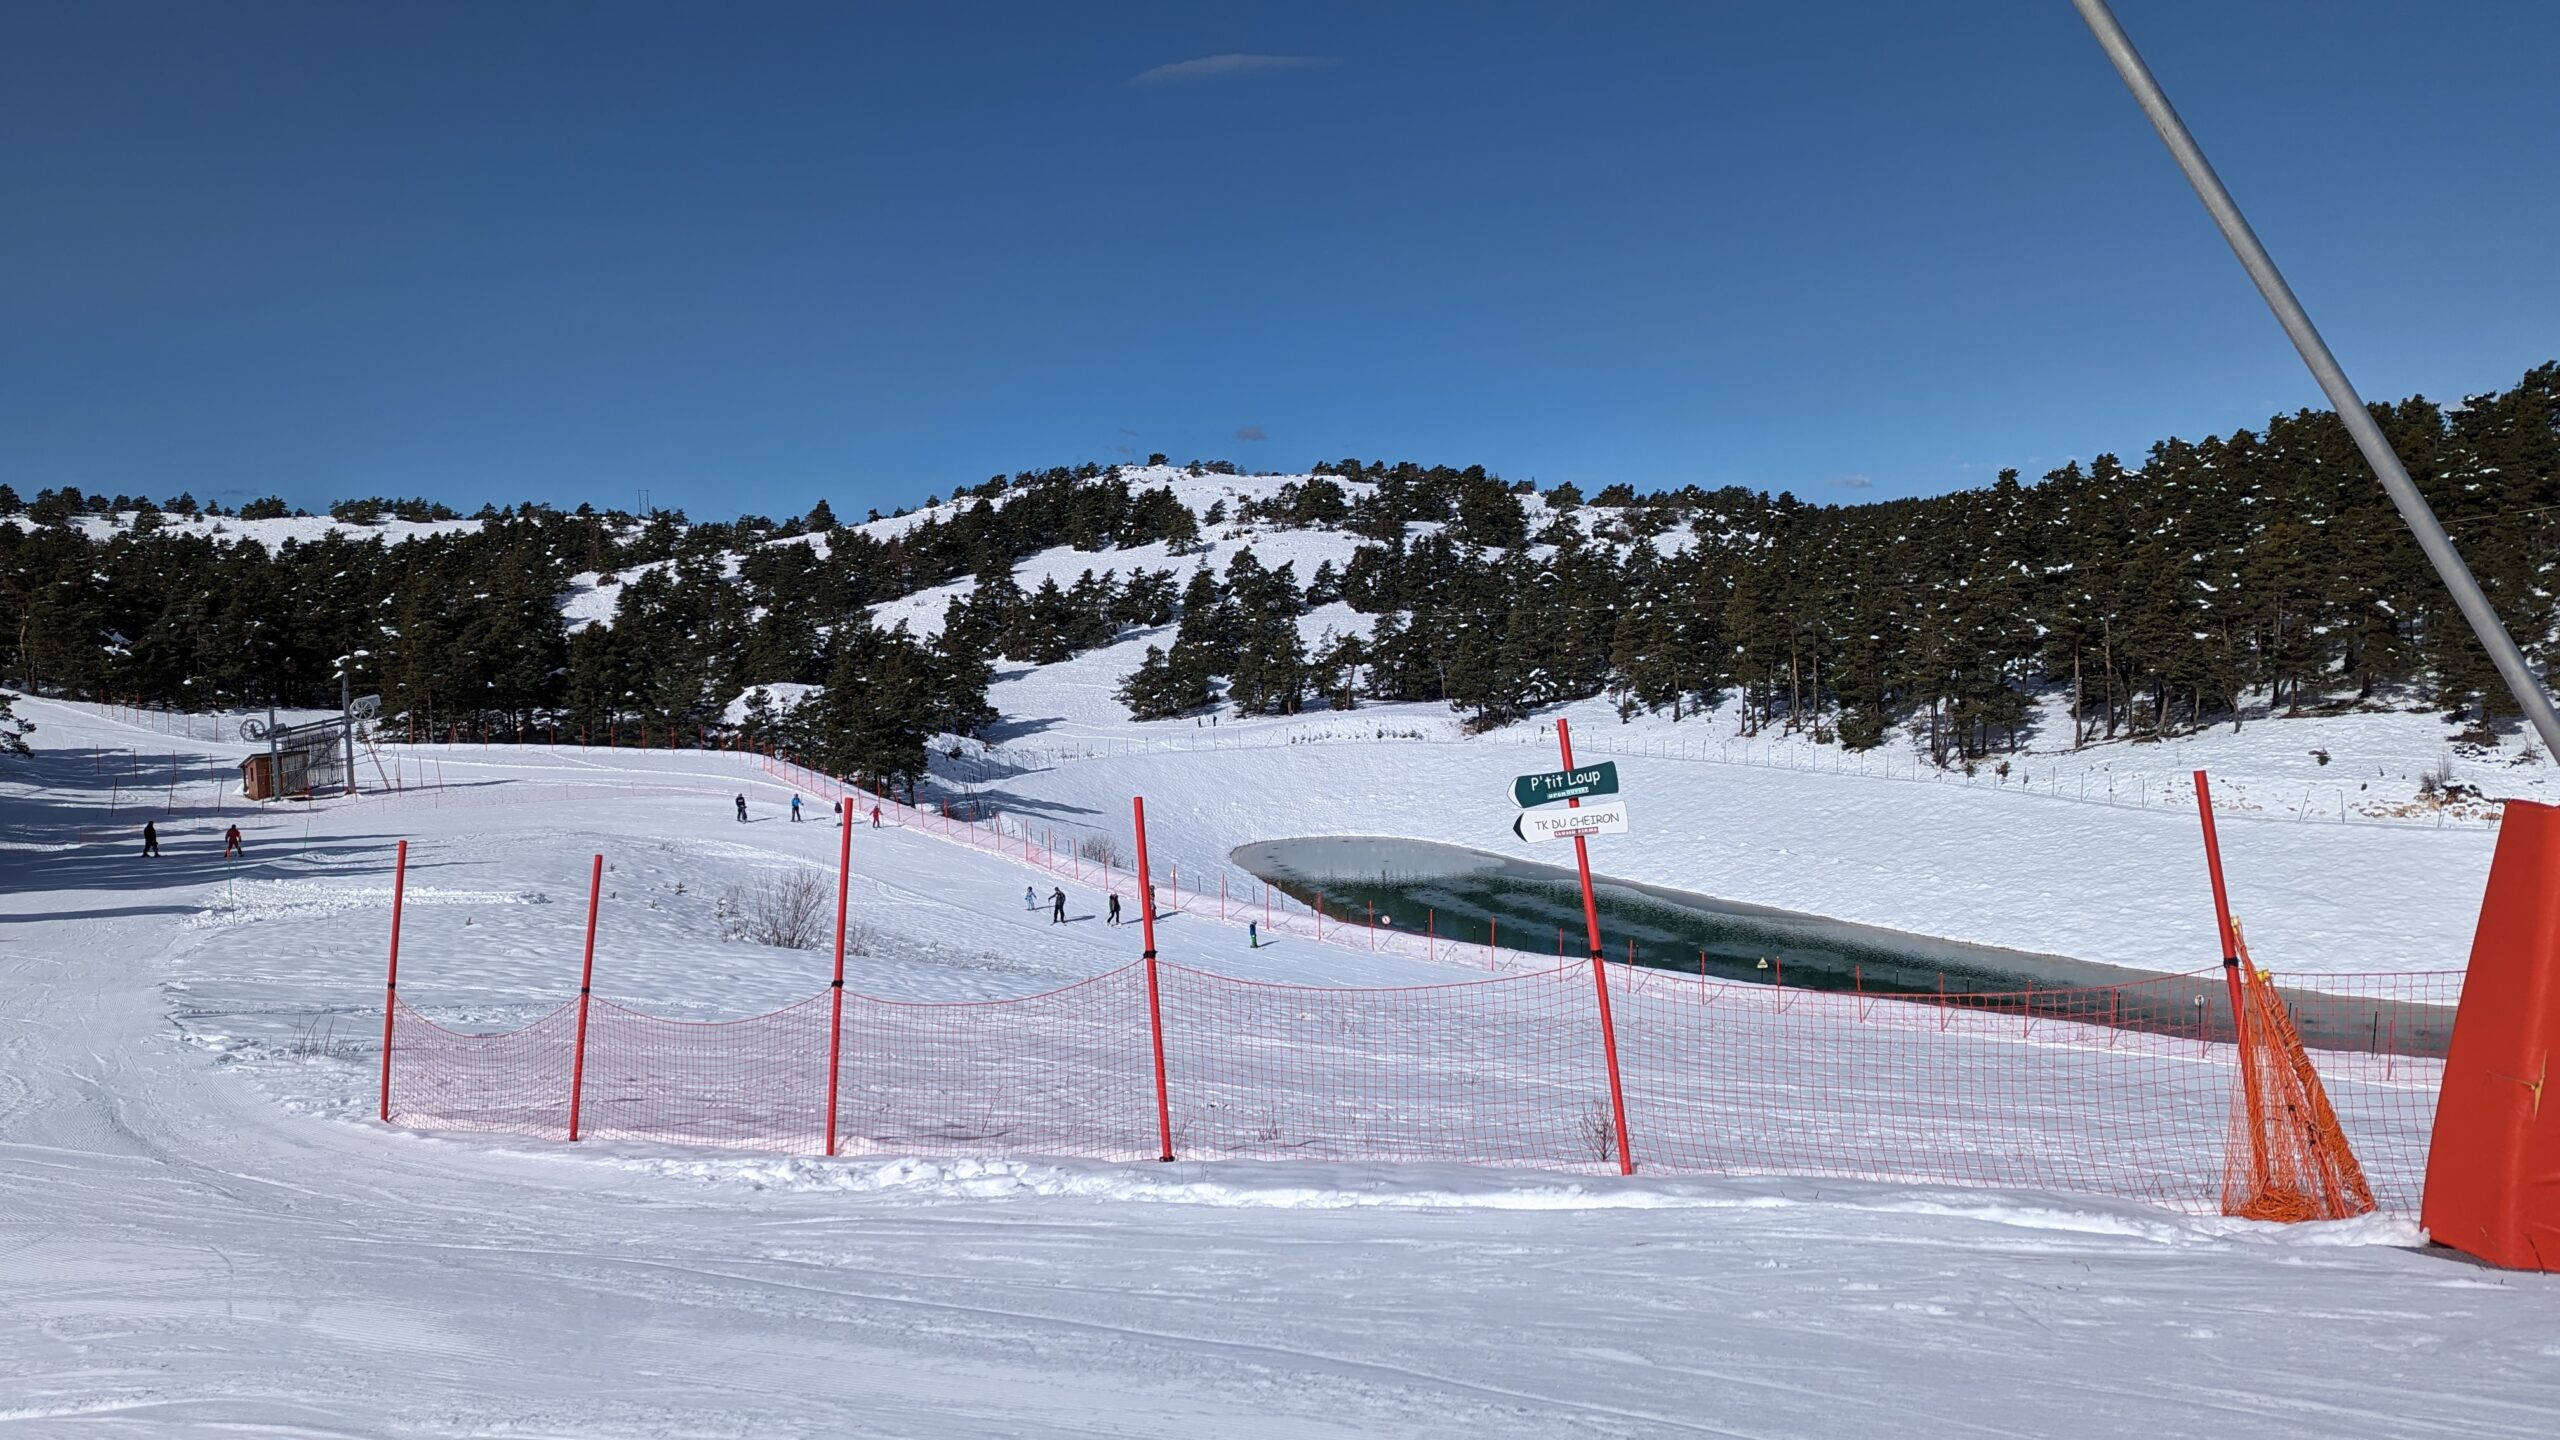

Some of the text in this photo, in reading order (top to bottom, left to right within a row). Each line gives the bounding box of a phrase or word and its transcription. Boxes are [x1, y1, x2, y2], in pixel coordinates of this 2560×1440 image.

[1531, 771, 1601, 791] P'tit Loup
[1534, 812, 1620, 831] TK DU CHEIRON
